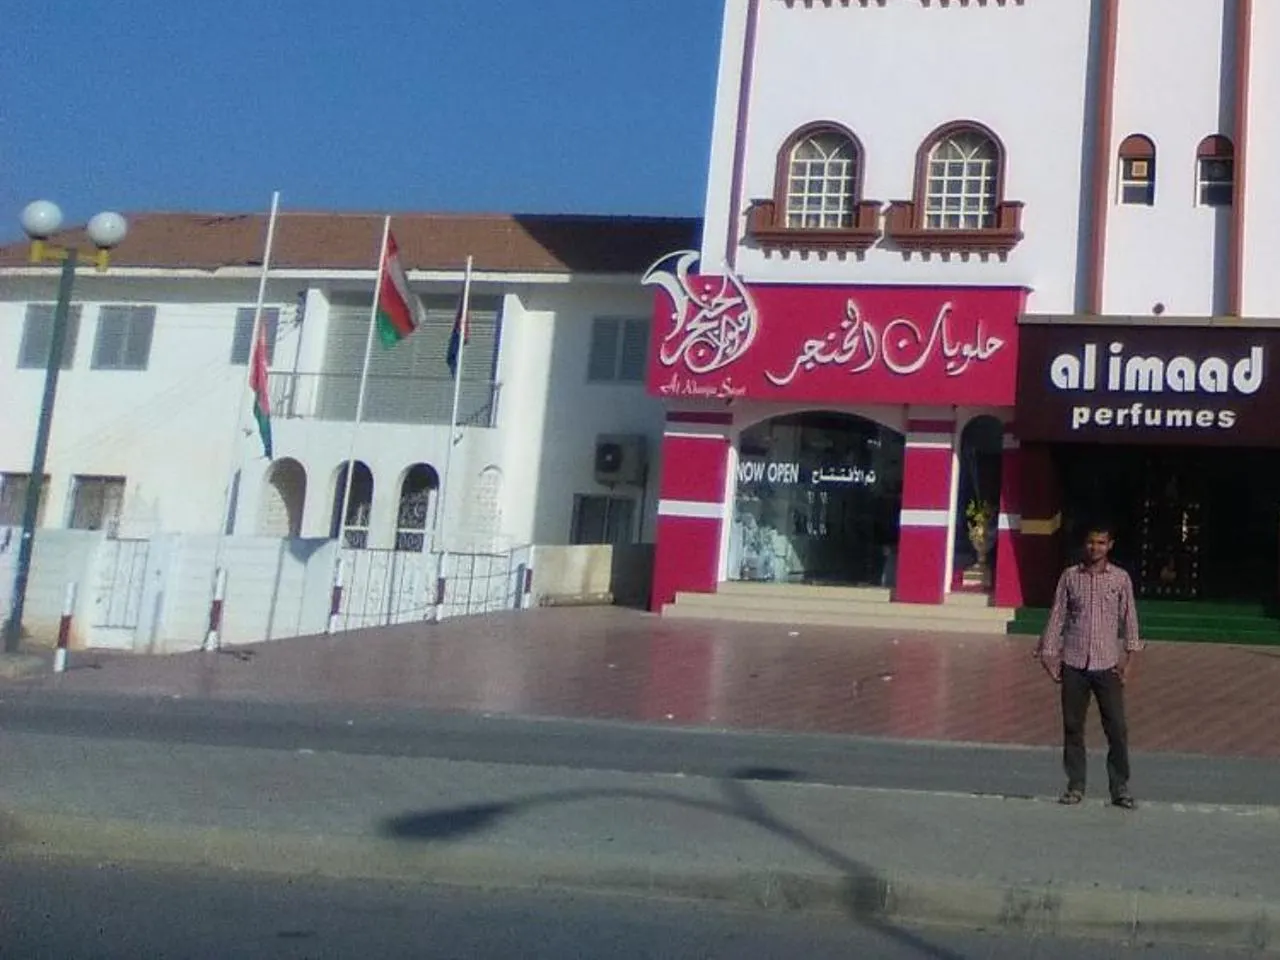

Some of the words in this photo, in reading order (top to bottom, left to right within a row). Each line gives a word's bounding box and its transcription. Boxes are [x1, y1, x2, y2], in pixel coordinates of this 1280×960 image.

[763, 298, 880, 386] الخنجر
[882, 301, 1004, 376] حلويات
[1050, 343, 1097, 390] al
[1108, 342, 1265, 395] imaad
[1072, 403, 1237, 429] perfumes
[737, 462, 766, 484] NOW
[767, 462, 800, 483] OPEN
